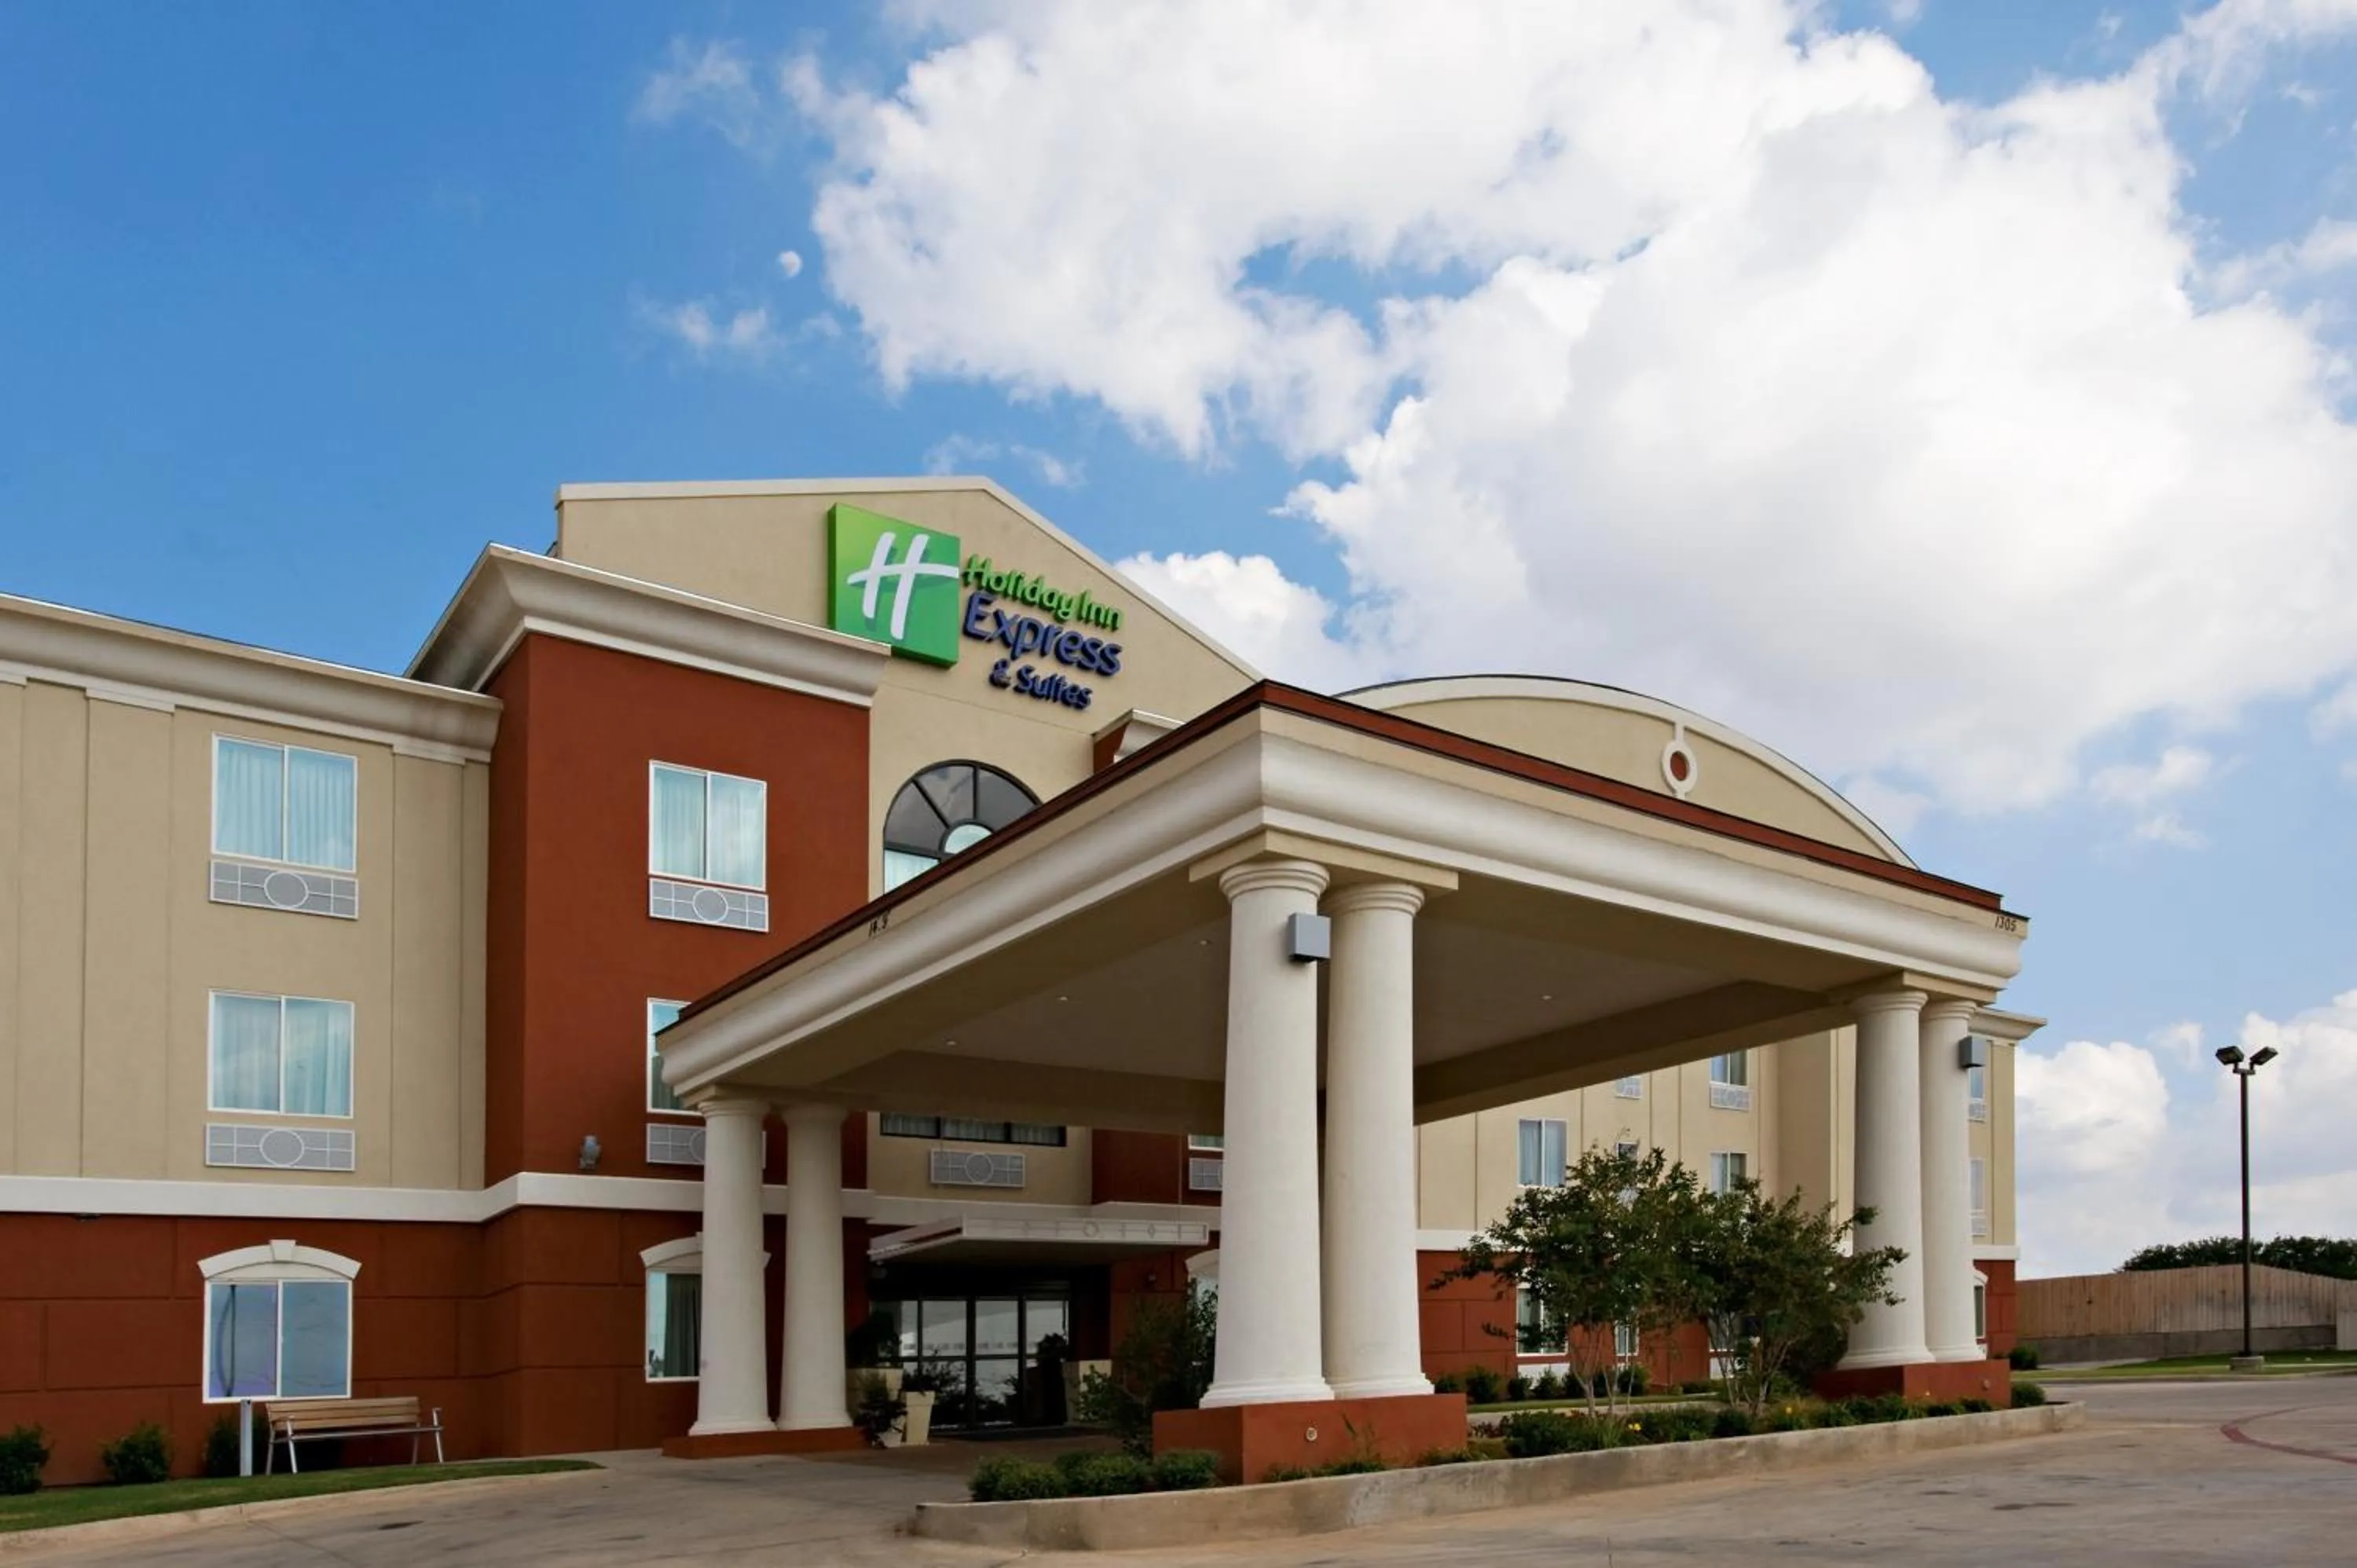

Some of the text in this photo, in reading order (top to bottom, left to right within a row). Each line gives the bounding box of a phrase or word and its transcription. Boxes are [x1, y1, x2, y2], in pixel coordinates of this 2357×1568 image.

[962, 554, 1122, 632] Holiday Inn
[962, 589, 1123, 676] Express
[988, 658, 1093, 710] & Suites
